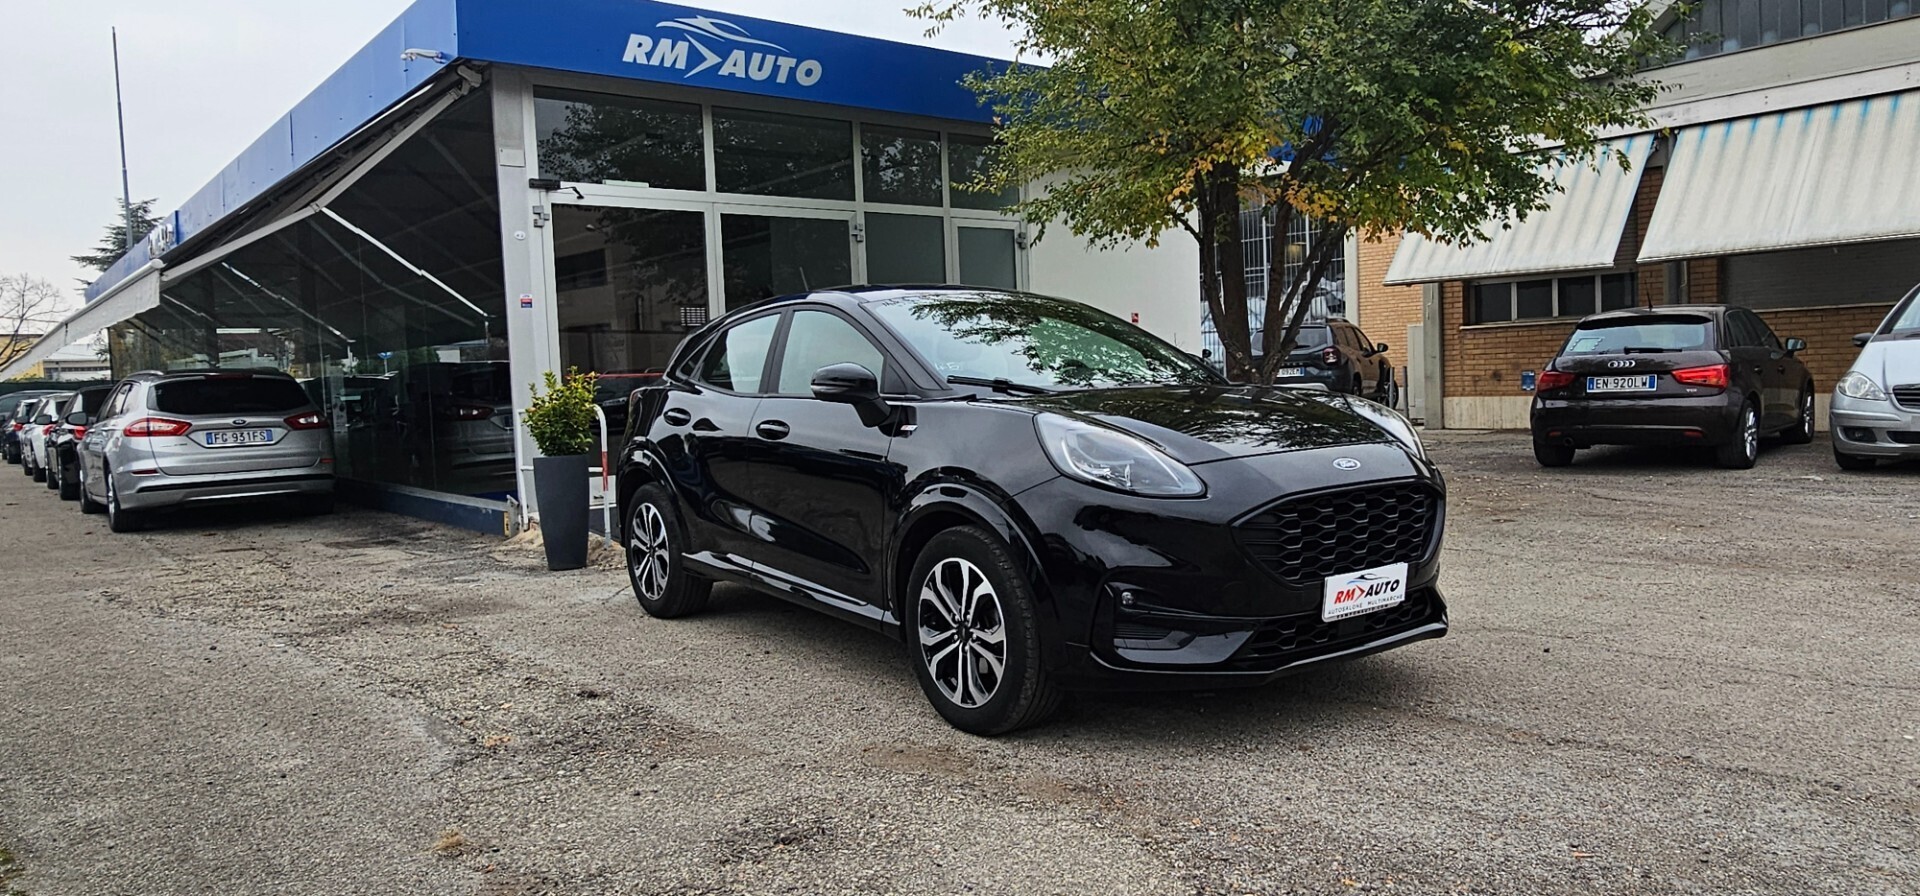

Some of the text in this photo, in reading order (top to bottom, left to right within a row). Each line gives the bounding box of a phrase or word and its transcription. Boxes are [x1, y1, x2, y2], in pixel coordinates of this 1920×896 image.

[1596, 377, 1647, 388] EN 920LW
[214, 431, 266, 443] FG 931FS
[1328, 594, 1403, 615] AUTOSALONE MULTIMARCHE
